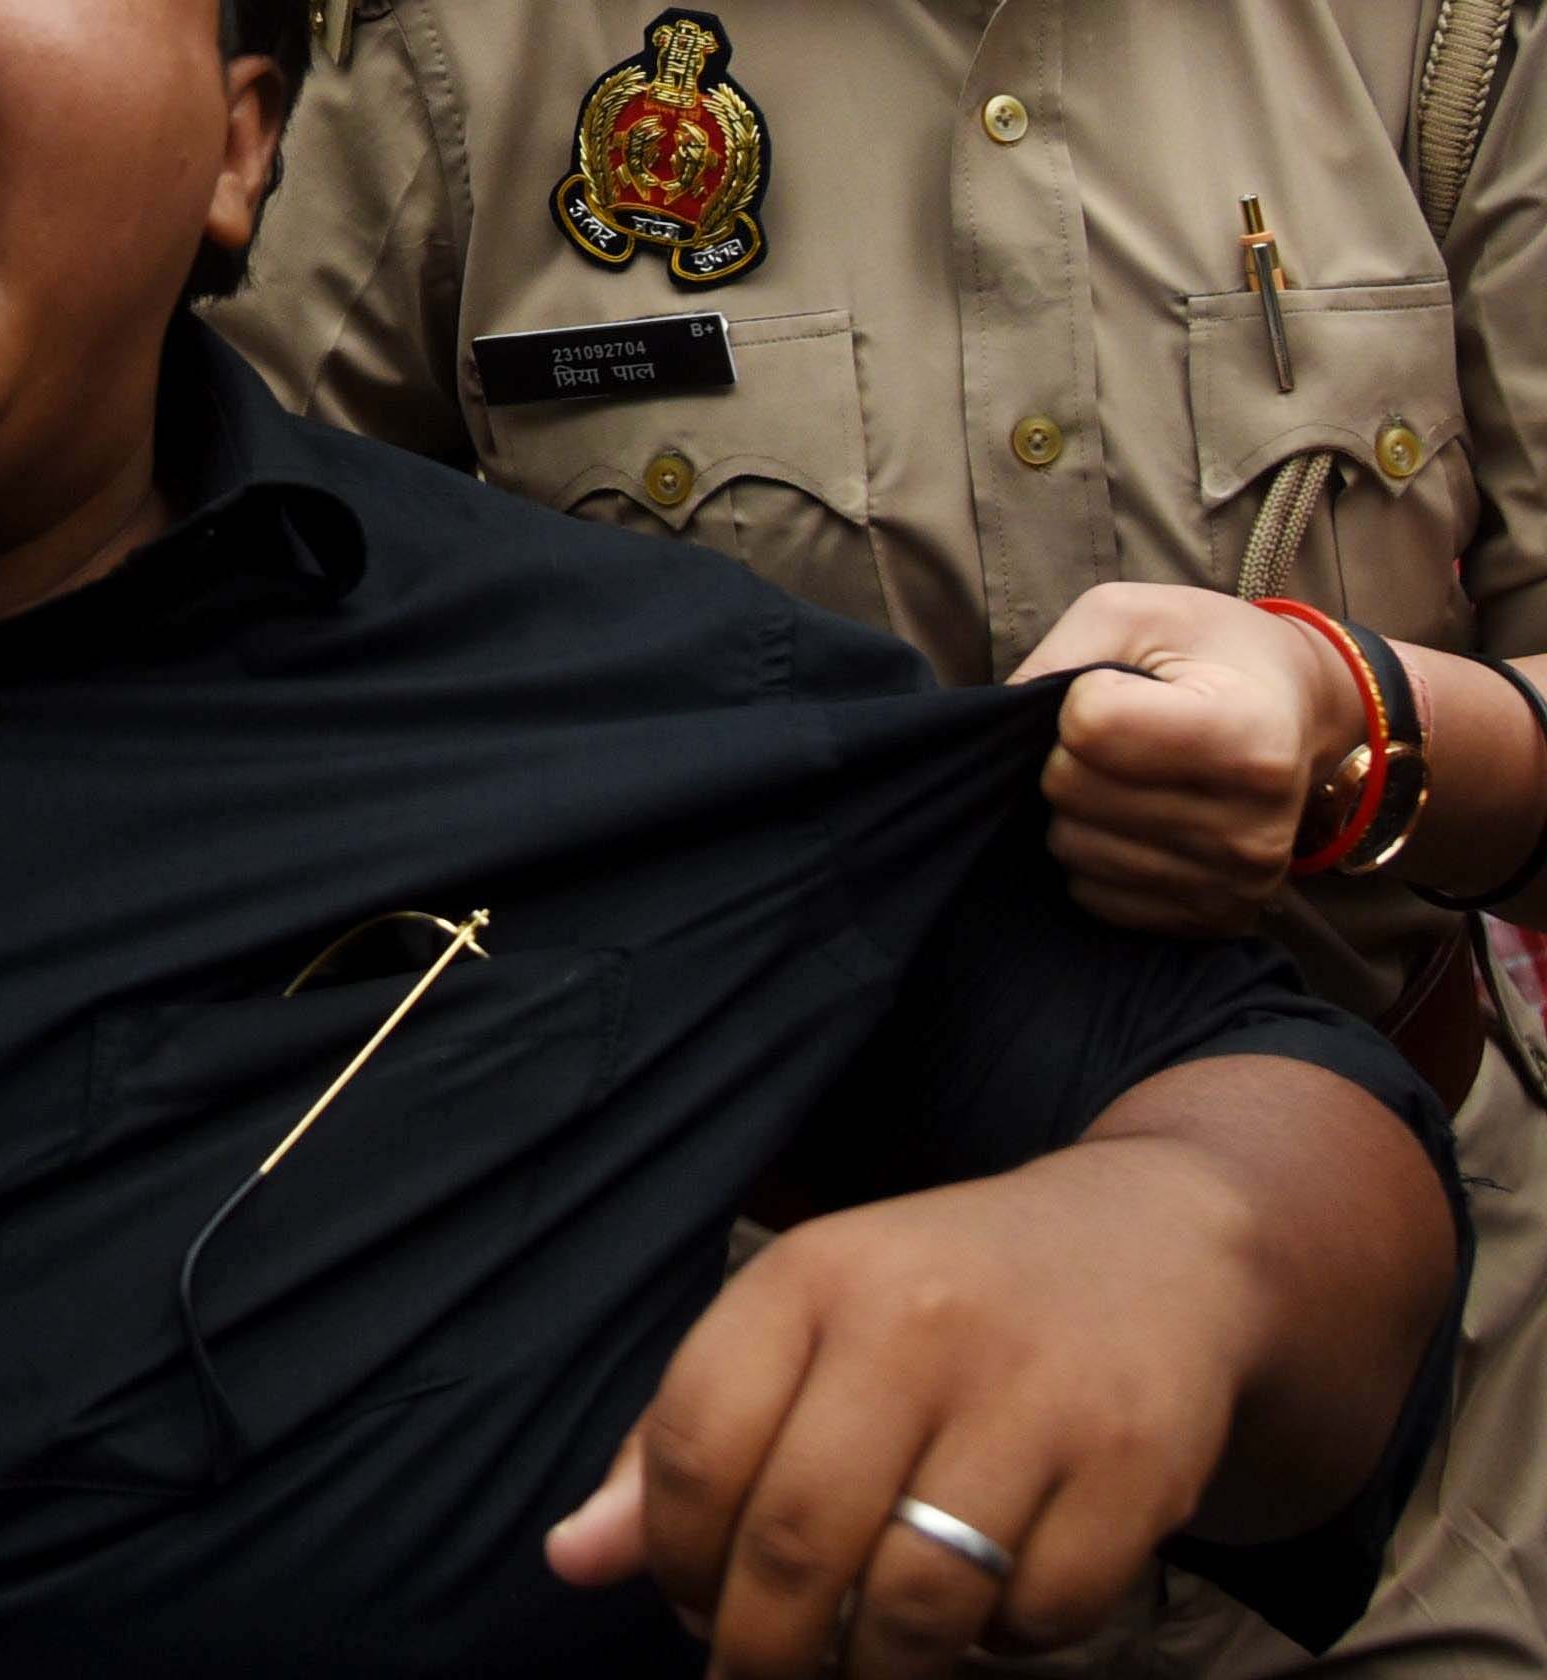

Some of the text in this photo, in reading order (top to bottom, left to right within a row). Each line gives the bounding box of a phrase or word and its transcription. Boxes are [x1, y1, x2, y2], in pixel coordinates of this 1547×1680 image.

[690, 322, 715, 338] B+
[552, 340, 647, 363] 231092704
[554, 362, 656, 388] प्रिया पाल
